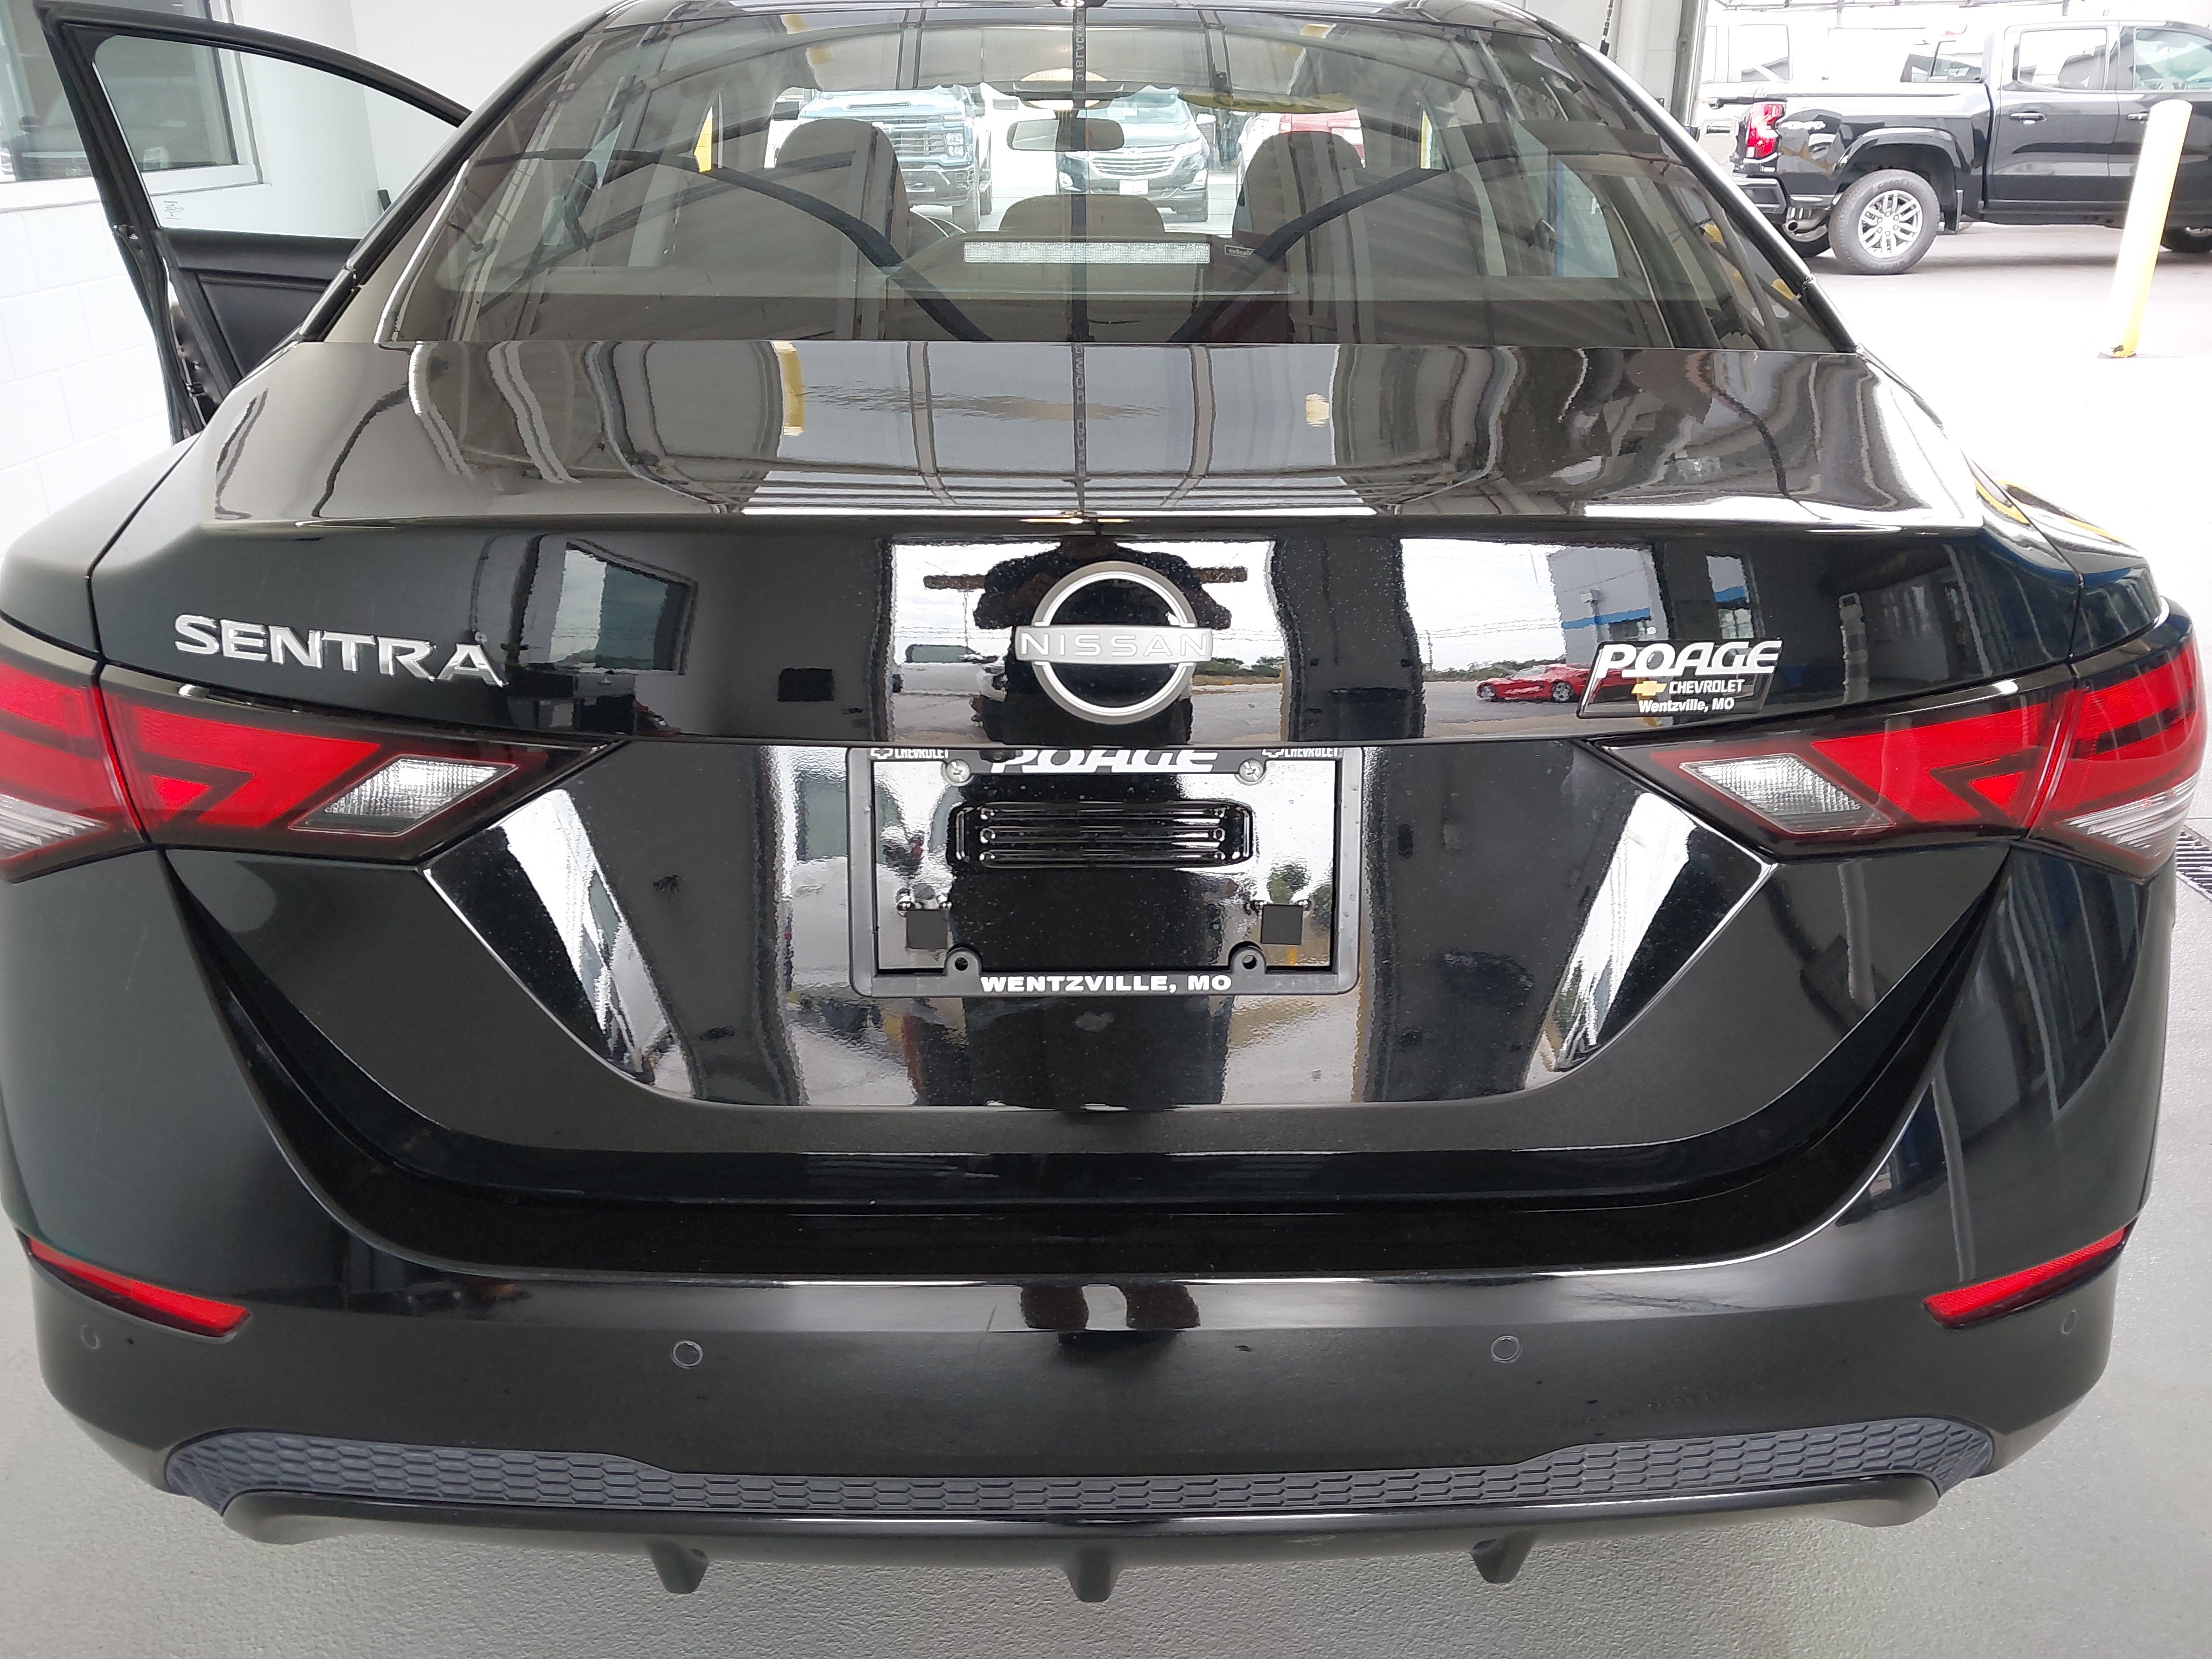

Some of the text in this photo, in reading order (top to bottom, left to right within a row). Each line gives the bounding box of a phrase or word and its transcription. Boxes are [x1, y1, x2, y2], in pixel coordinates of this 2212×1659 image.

[174, 613, 510, 687] SENTRA
[1021, 633, 1207, 657] NISSAN
[1595, 640, 1783, 678] POAGE
[1669, 679, 1745, 695] CHEVROLET
[1638, 697, 1735, 713] Wentzville, MO
[980, 974, 1232, 993] WENTZVILLE, MO
